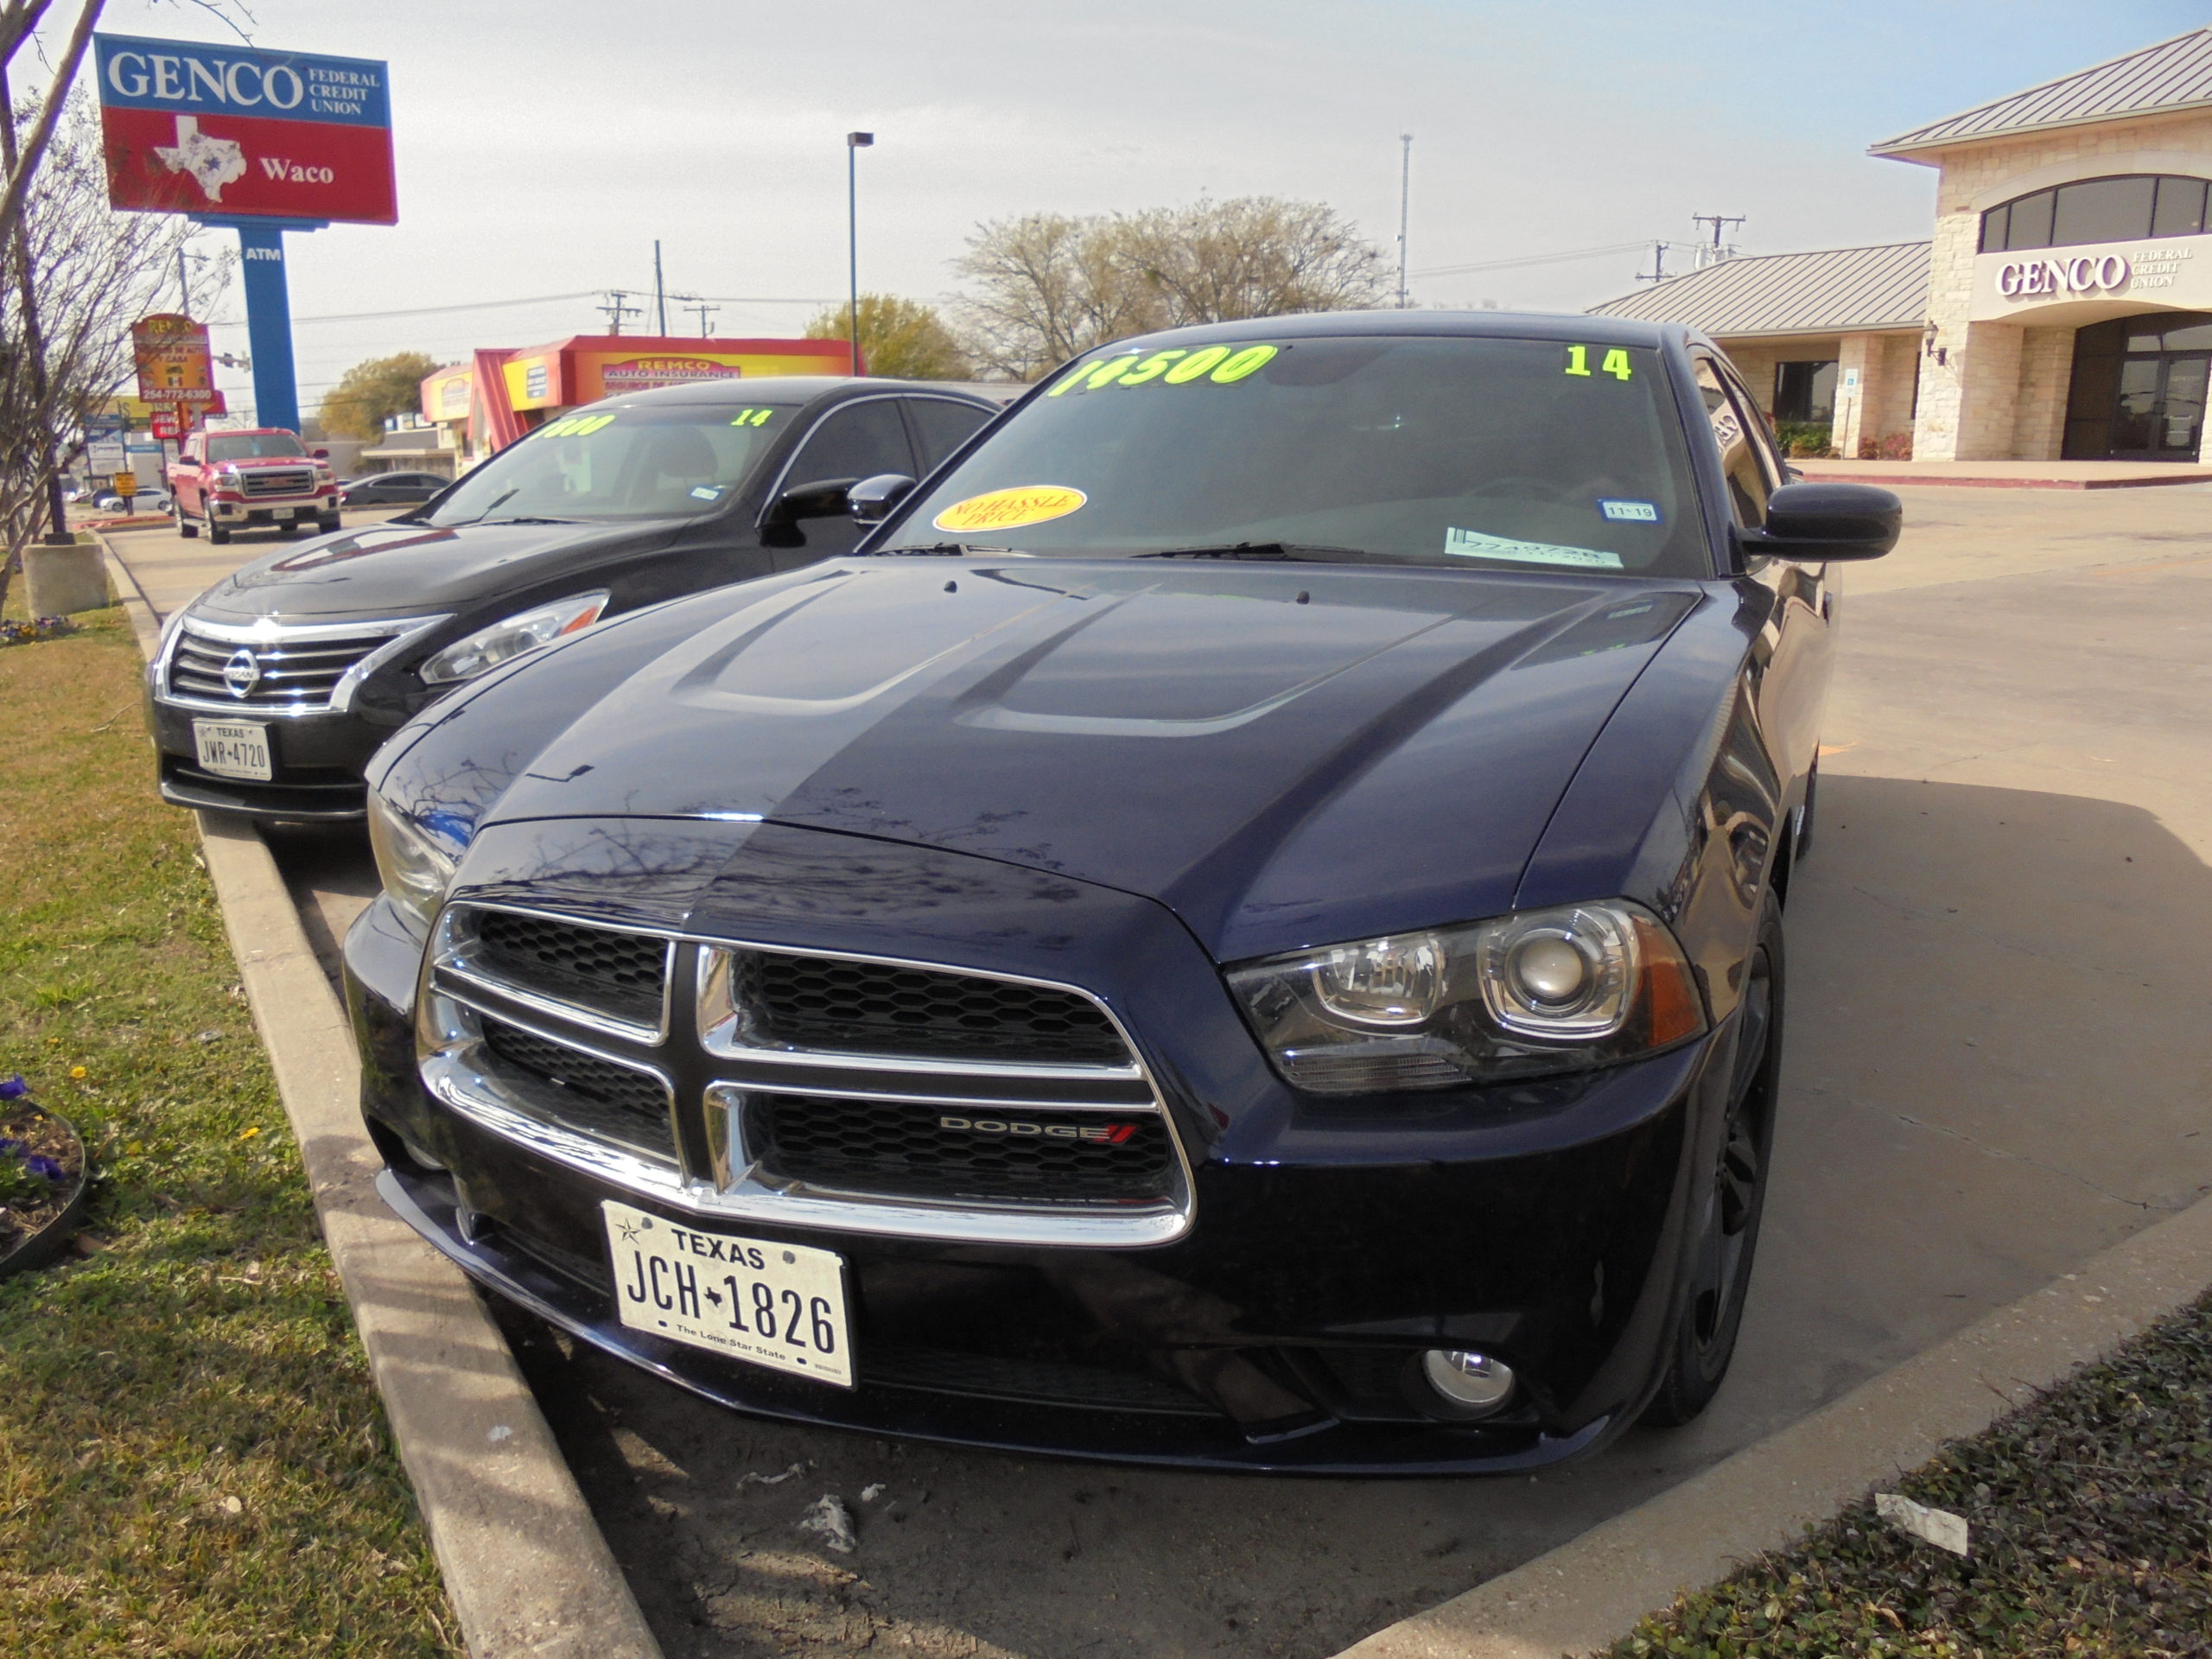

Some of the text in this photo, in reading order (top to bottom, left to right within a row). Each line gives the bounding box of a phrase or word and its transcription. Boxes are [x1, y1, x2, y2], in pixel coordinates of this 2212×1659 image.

[108, 51, 304, 110] GENCO
[308, 68, 380, 88] FEDERAL
[309, 83, 368, 101] CREDIT
[311, 99, 361, 116] UNION
[260, 157, 335, 185] Waco
[245, 247, 282, 261] ATM
[2133, 248, 2193, 264] FEDERAL
[1994, 254, 2129, 297] GENCO
[2131, 262, 2178, 276] CREDIT
[2130, 276, 2176, 289] UNION
[637, 360, 710, 371] REMCO
[1047, 345, 1279, 397] 14500
[1565, 345, 1632, 381] 14
[654, 371, 734, 379] INSURANCE
[731, 409, 773, 427] 14
[956, 494, 1071, 516] NO HASSLE
[961, 508, 1027, 526] PRICE
[216, 727, 245, 738] TEXAS
[940, 1116, 1111, 1140] DODGE
[671, 1228, 766, 1271] TEXAS
[676, 1324, 786, 1361] The Lone Star State
